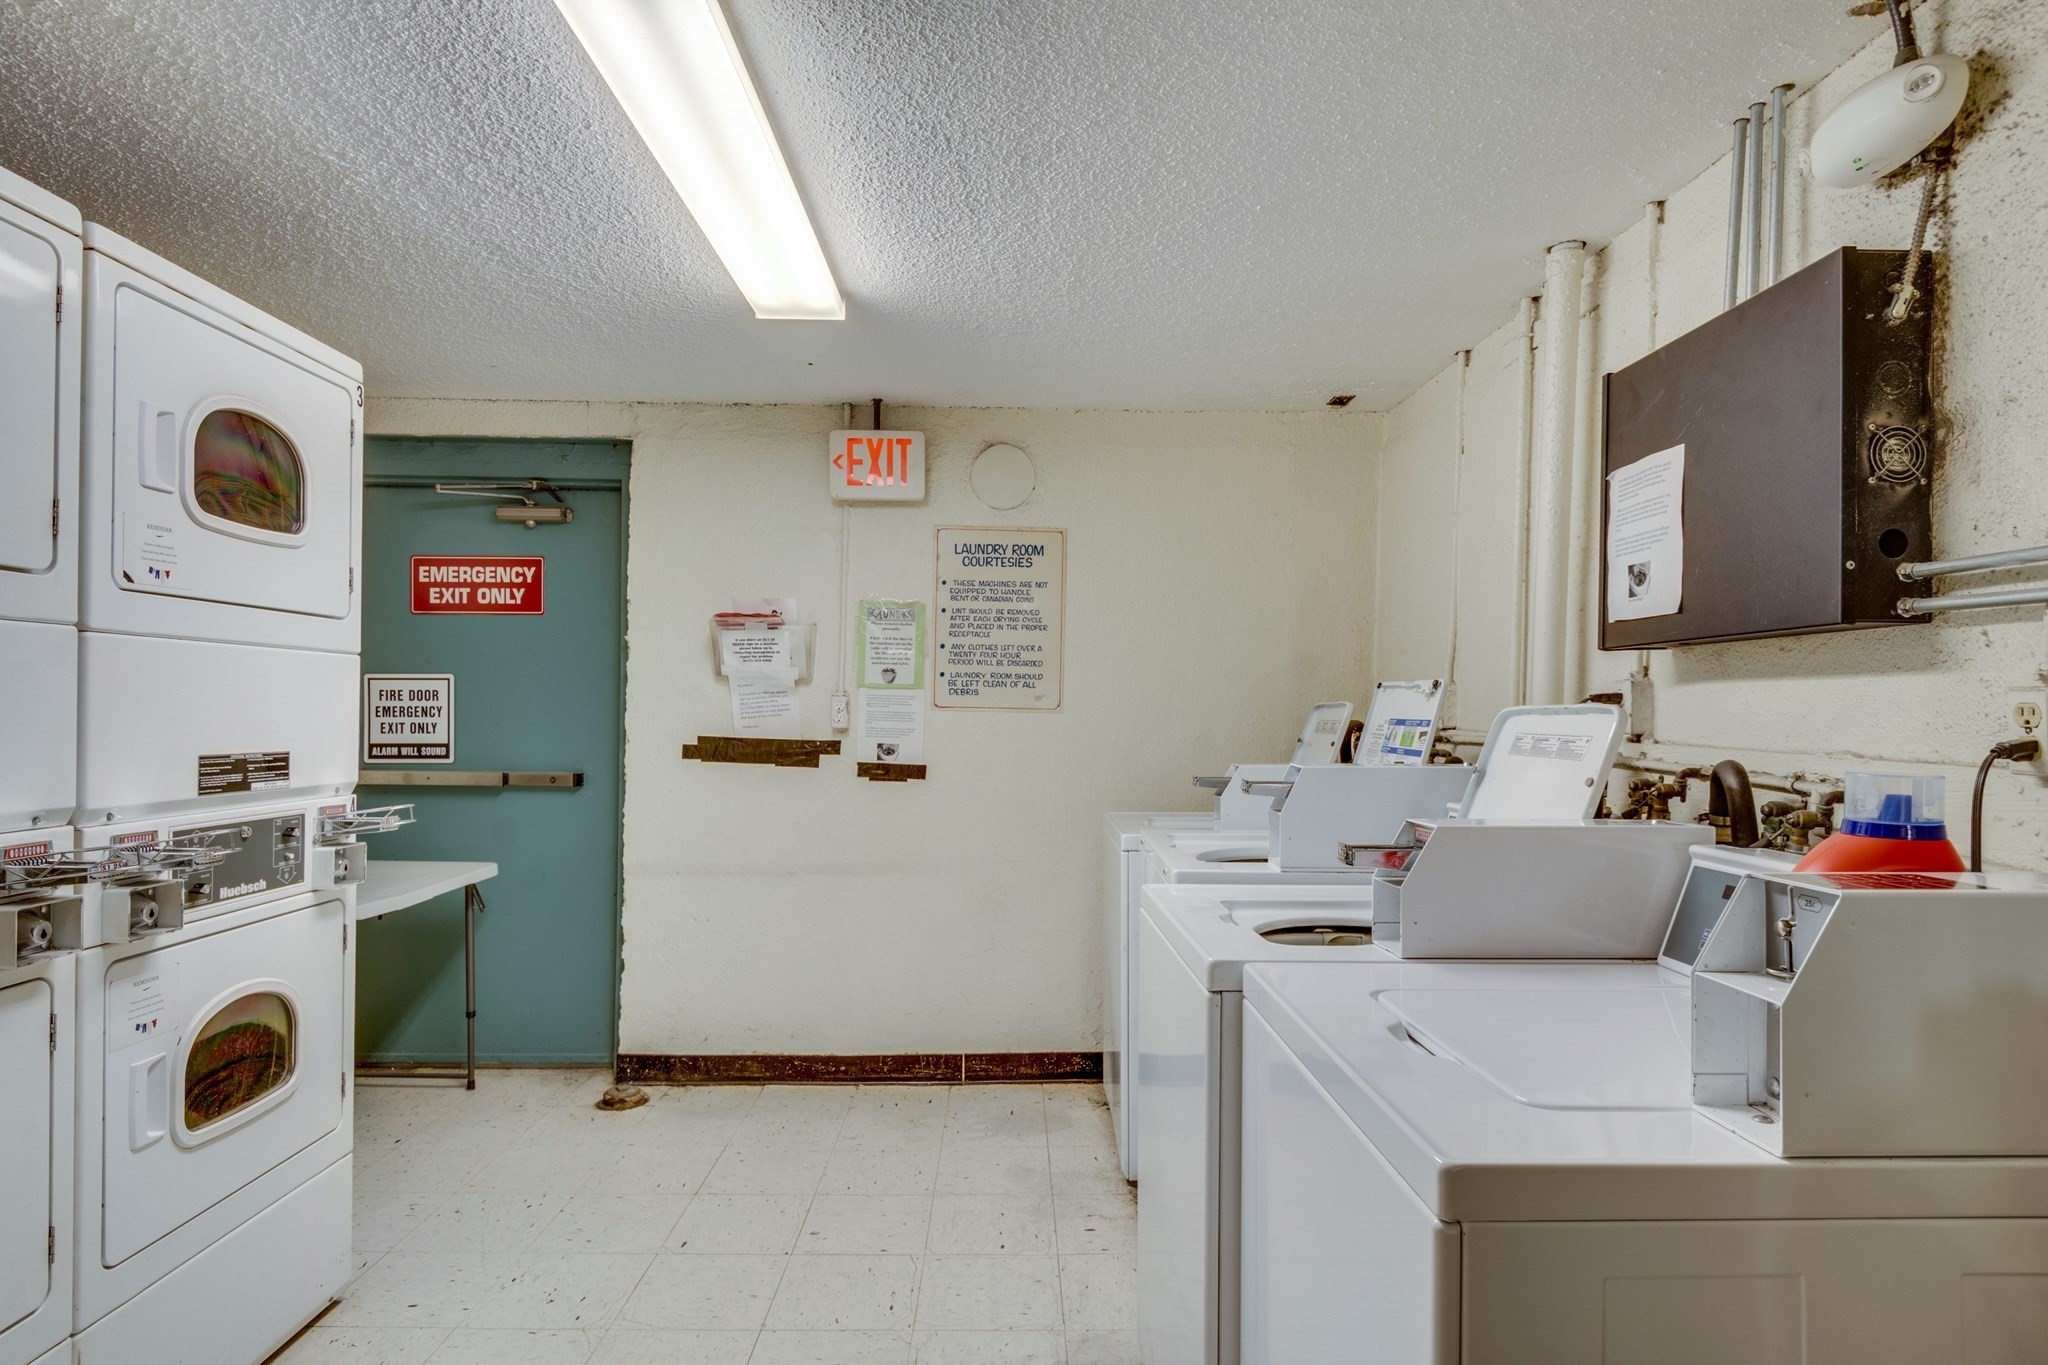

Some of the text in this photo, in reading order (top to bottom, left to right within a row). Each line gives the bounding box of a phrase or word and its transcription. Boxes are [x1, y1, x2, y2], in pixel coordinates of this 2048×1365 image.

[356, 386, 363, 407] 3
[847, 437, 912, 486] EXIT
[954, 543, 1044, 556] LAUNDRY ROOM
[962, 556, 1033, 568] COURTESIES
[418, 566, 536, 583] EMERGENCY
[429, 588, 525, 604] EXIT ONLY
[379, 690, 439, 701] FIRE DOOR
[375, 706, 442, 718] EMERGENCY
[380, 722, 437, 734] EXIT ONLY
[372, 747, 446, 756] ALARM WILL SOUND
[220, 878, 266, 900] Huebsch
